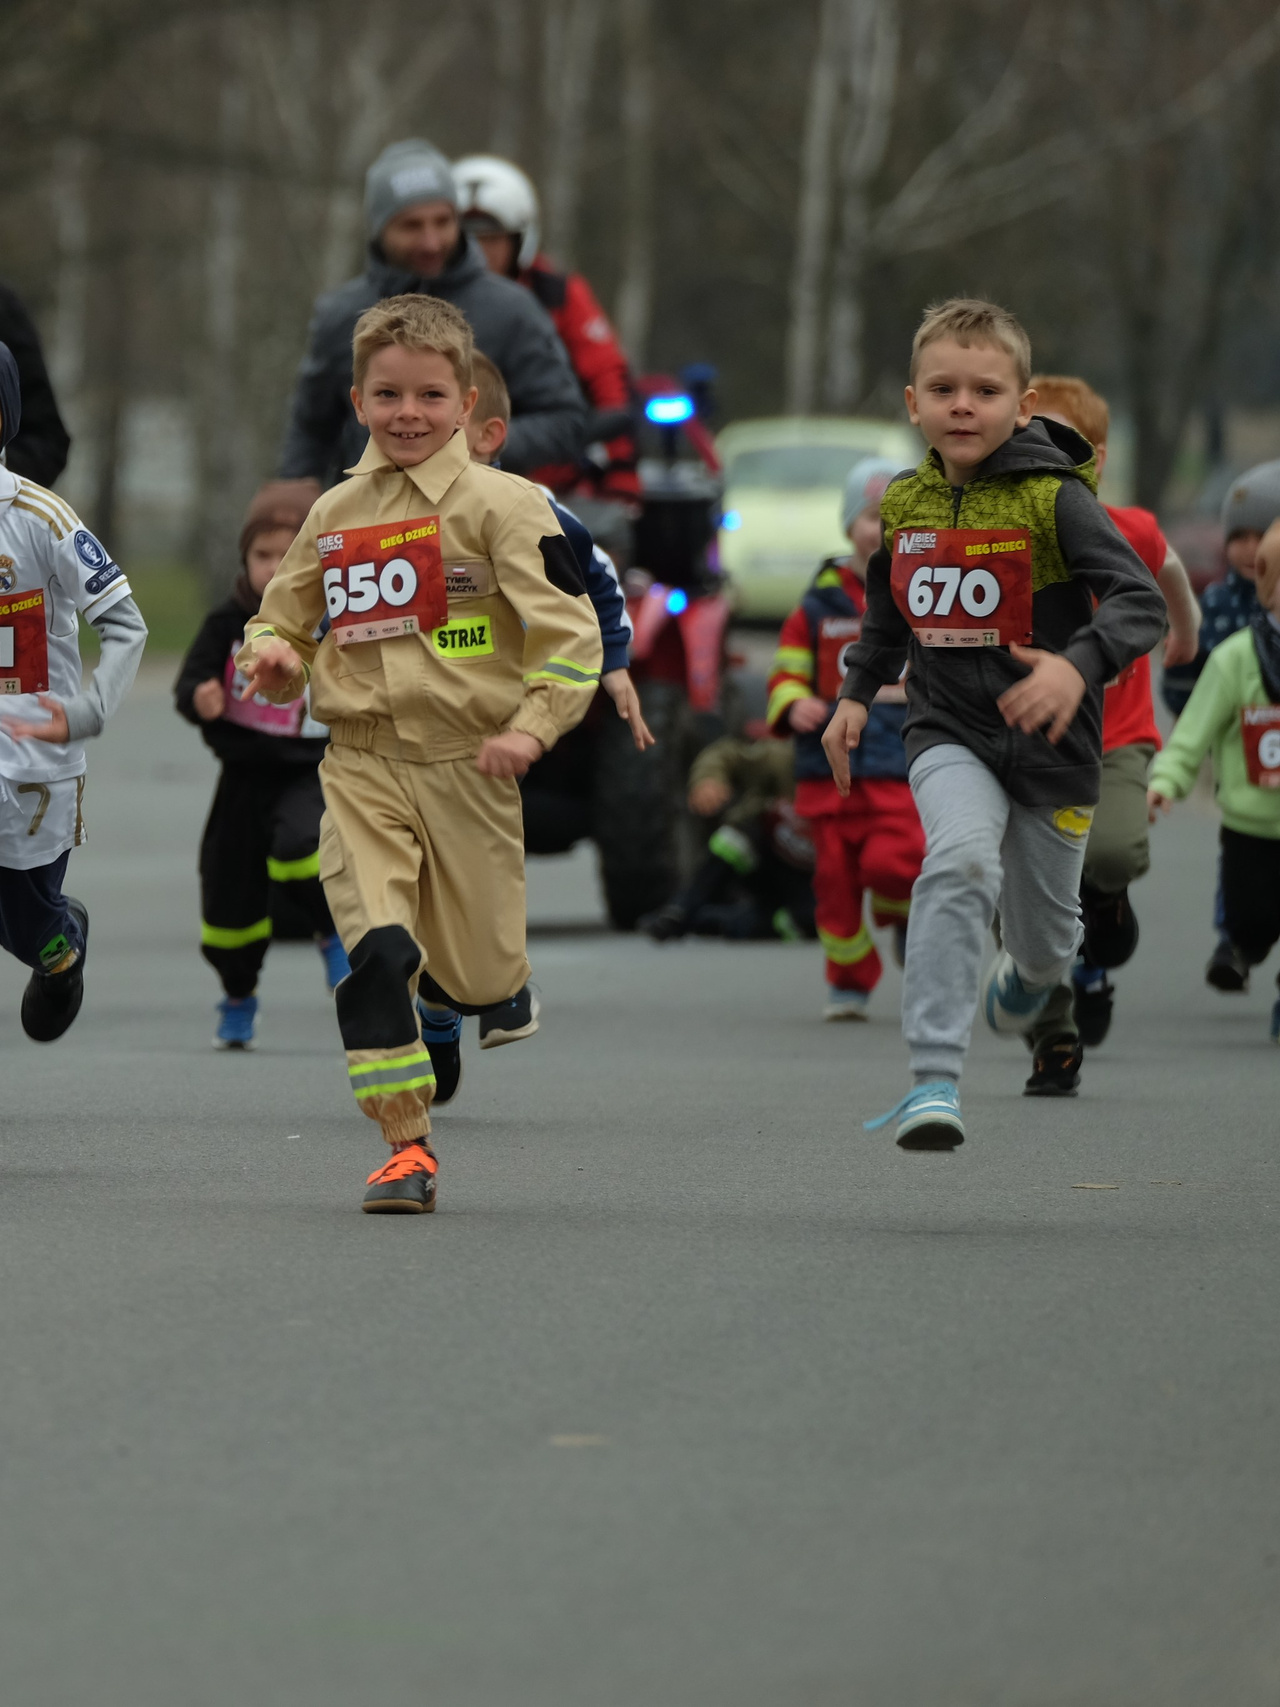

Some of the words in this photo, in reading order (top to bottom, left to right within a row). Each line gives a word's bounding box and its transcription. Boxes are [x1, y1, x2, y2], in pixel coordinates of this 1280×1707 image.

[380, 534, 404, 550] BIEG
[405, 525, 437, 542] DZIECI
[914, 533, 937, 543] BIEG
[965, 544, 990, 556] BIEG
[991, 540, 1026, 553] DZIECI
[323, 558, 418, 620] 650
[445, 576, 472, 584] TYMEK
[908, 566, 1001, 618] 670
[11, 595, 43, 613] DZIECI
[17, 783, 51, 836] 7
